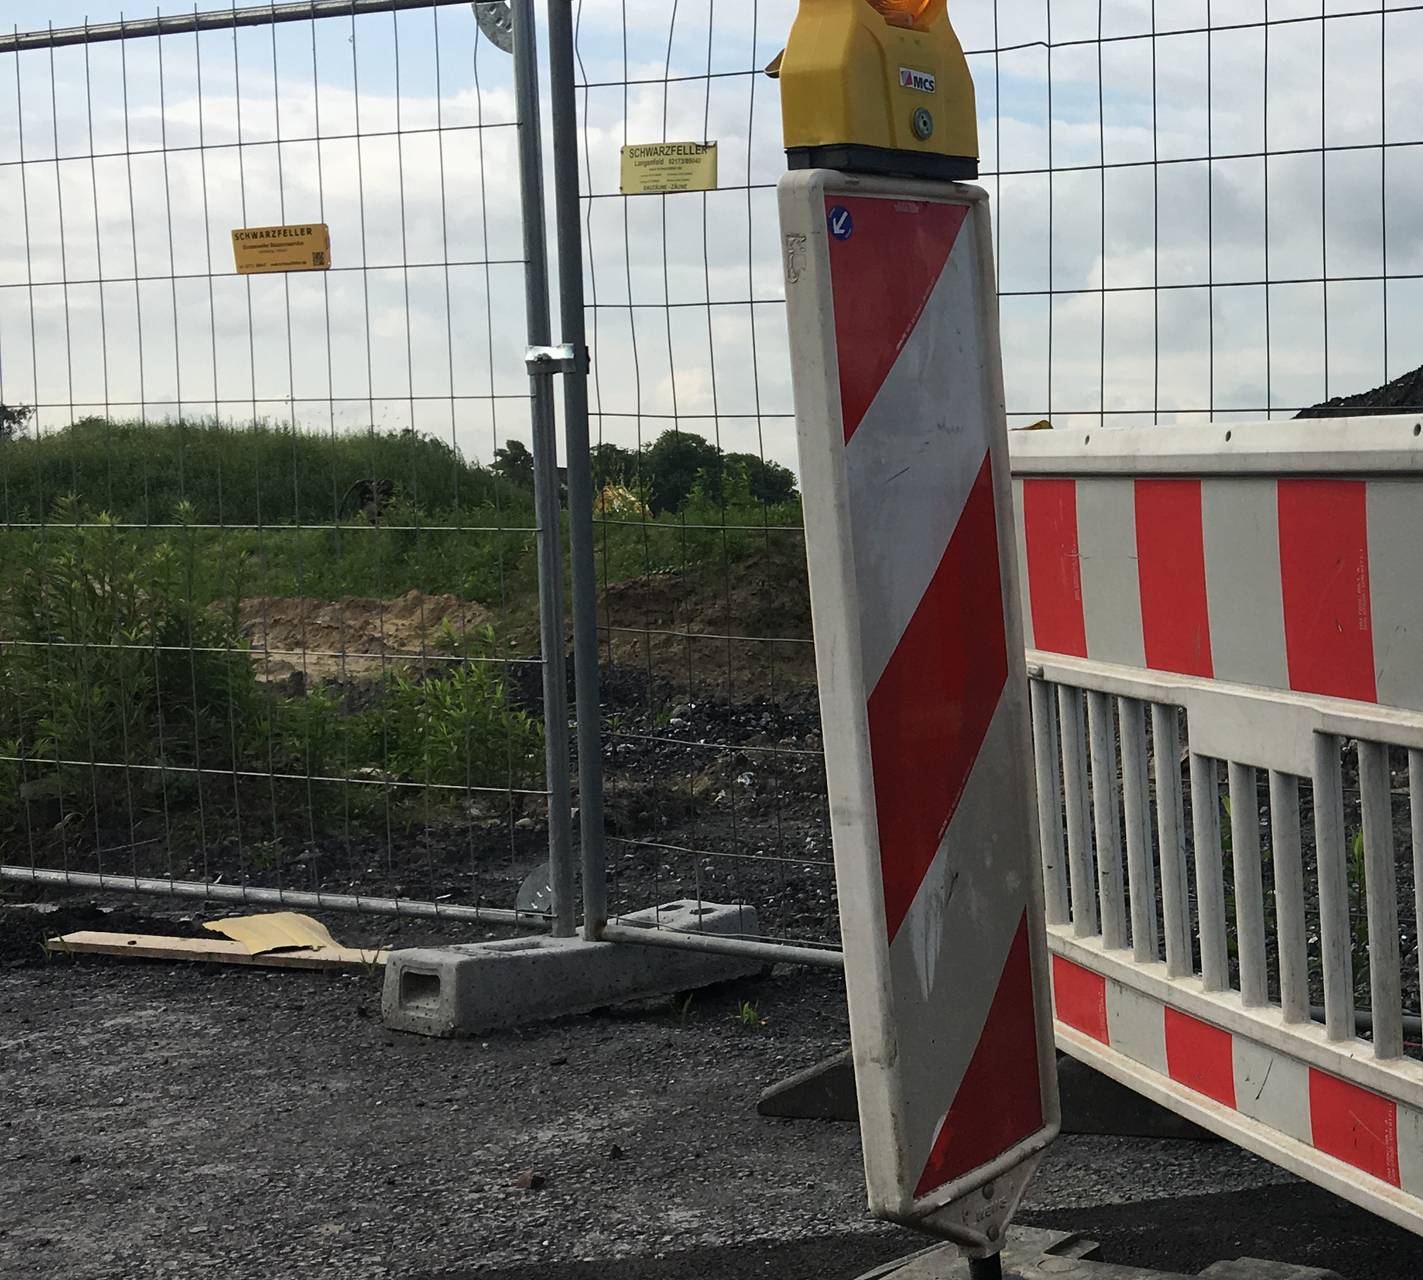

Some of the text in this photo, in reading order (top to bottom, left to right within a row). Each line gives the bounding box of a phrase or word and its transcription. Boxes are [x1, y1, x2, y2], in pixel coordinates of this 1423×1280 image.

[913, 76, 934, 92] MCS
[629, 145, 708, 159] SCHWARZFELLER
[234, 227, 313, 241] SCHWARZFELLER
